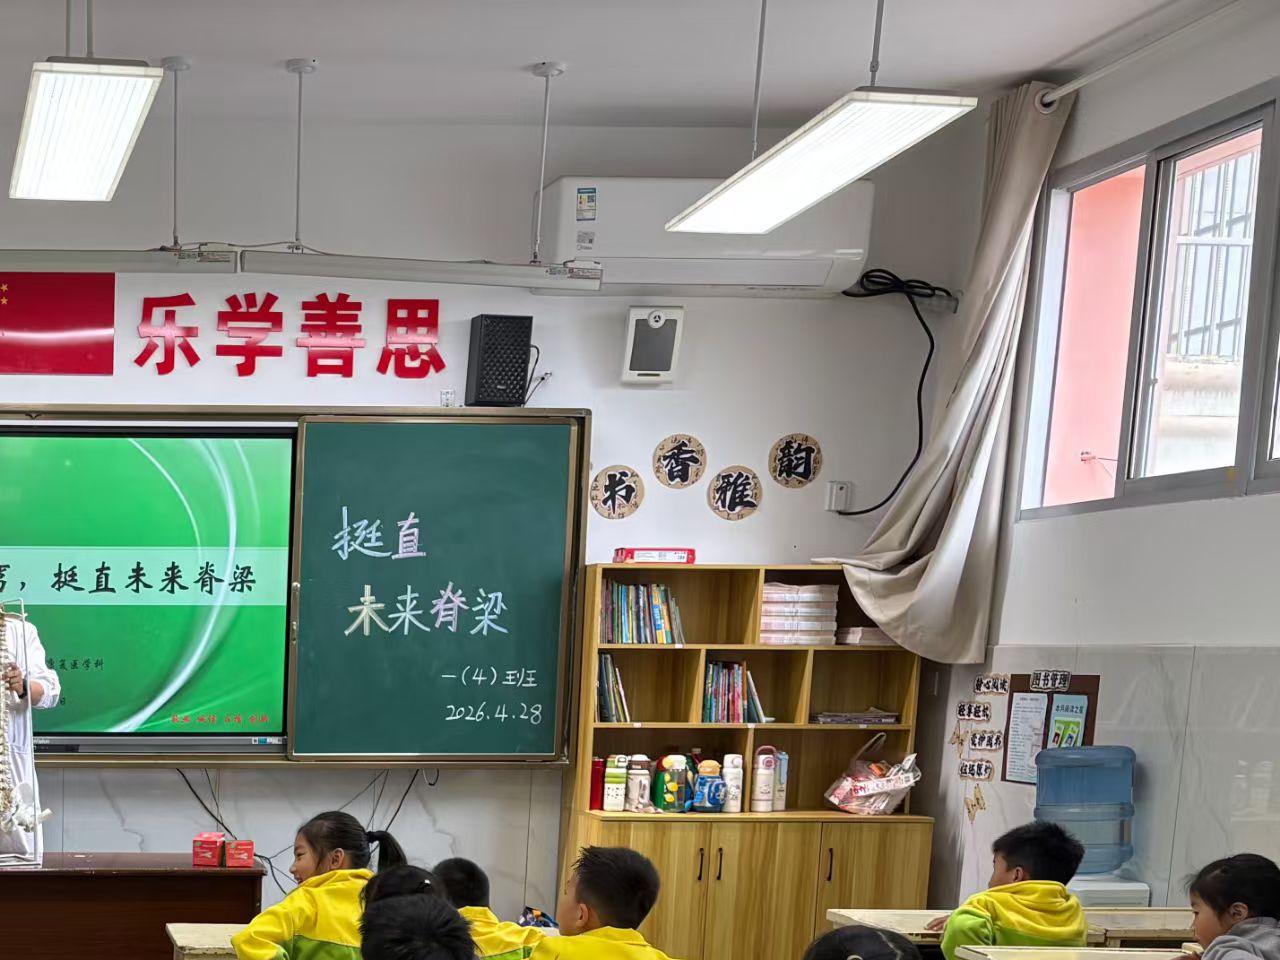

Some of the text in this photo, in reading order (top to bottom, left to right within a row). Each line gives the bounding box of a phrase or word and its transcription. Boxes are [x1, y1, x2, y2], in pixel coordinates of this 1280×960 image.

[133, 292, 446, 379] 乐学善思
[602, 440, 816, 514] 书 香 雅 韵
[331, 506, 427, 560] 挺直
[344, 581, 509, 637] 未来脊梁
[445, 702, 542, 724] 2026.4.28
